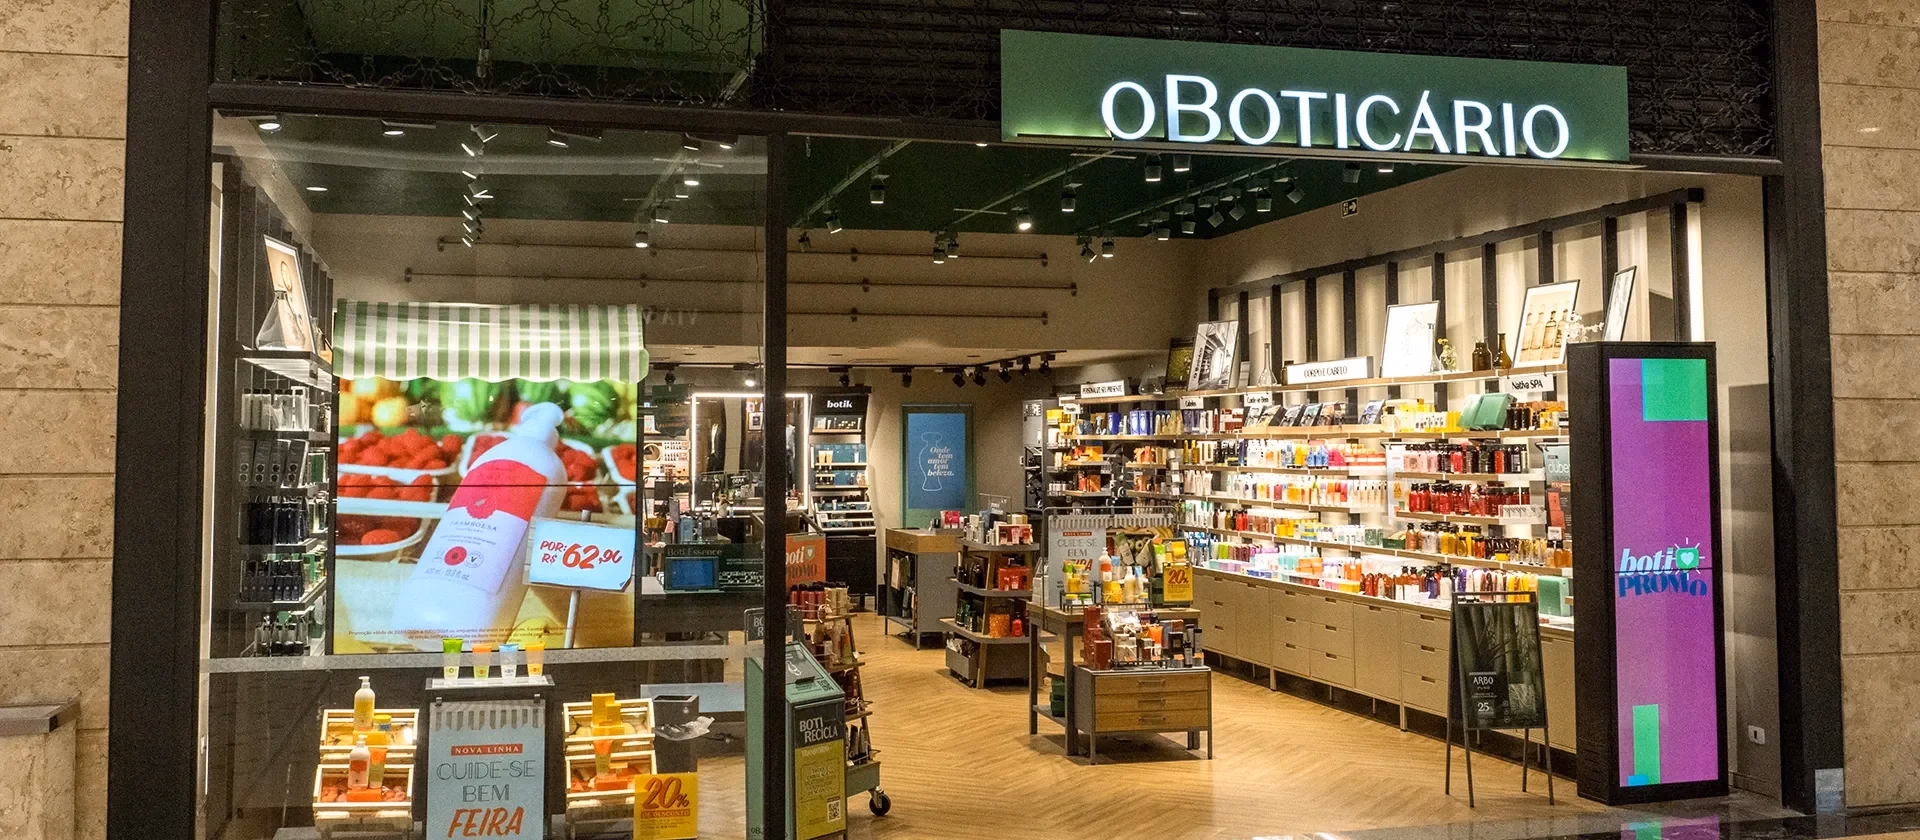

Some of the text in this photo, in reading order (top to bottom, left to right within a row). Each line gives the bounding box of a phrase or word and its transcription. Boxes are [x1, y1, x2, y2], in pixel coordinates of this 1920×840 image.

[1304, 368, 1322, 378] CORPO
[1323, 368, 1326, 376] E
[1512, 379, 1543, 389] Nativa SPA
[827, 400, 853, 408] botik
[540, 540, 567, 552] POR:
[687, 547, 722, 556] Essence
[541, 553, 558, 565] R$
[1619, 547, 1674, 576] boti
[1618, 573, 1707, 597] PROMO
[1473, 676, 1494, 685] ARBO
[799, 717, 824, 732] BOTI
[804, 725, 838, 744] RECICLA
[436, 760, 536, 780] CUIDE-SE
[462, 784, 510, 803] BEM
[642, 776, 689, 809] 20%
[447, 806, 525, 838] FEIRA
